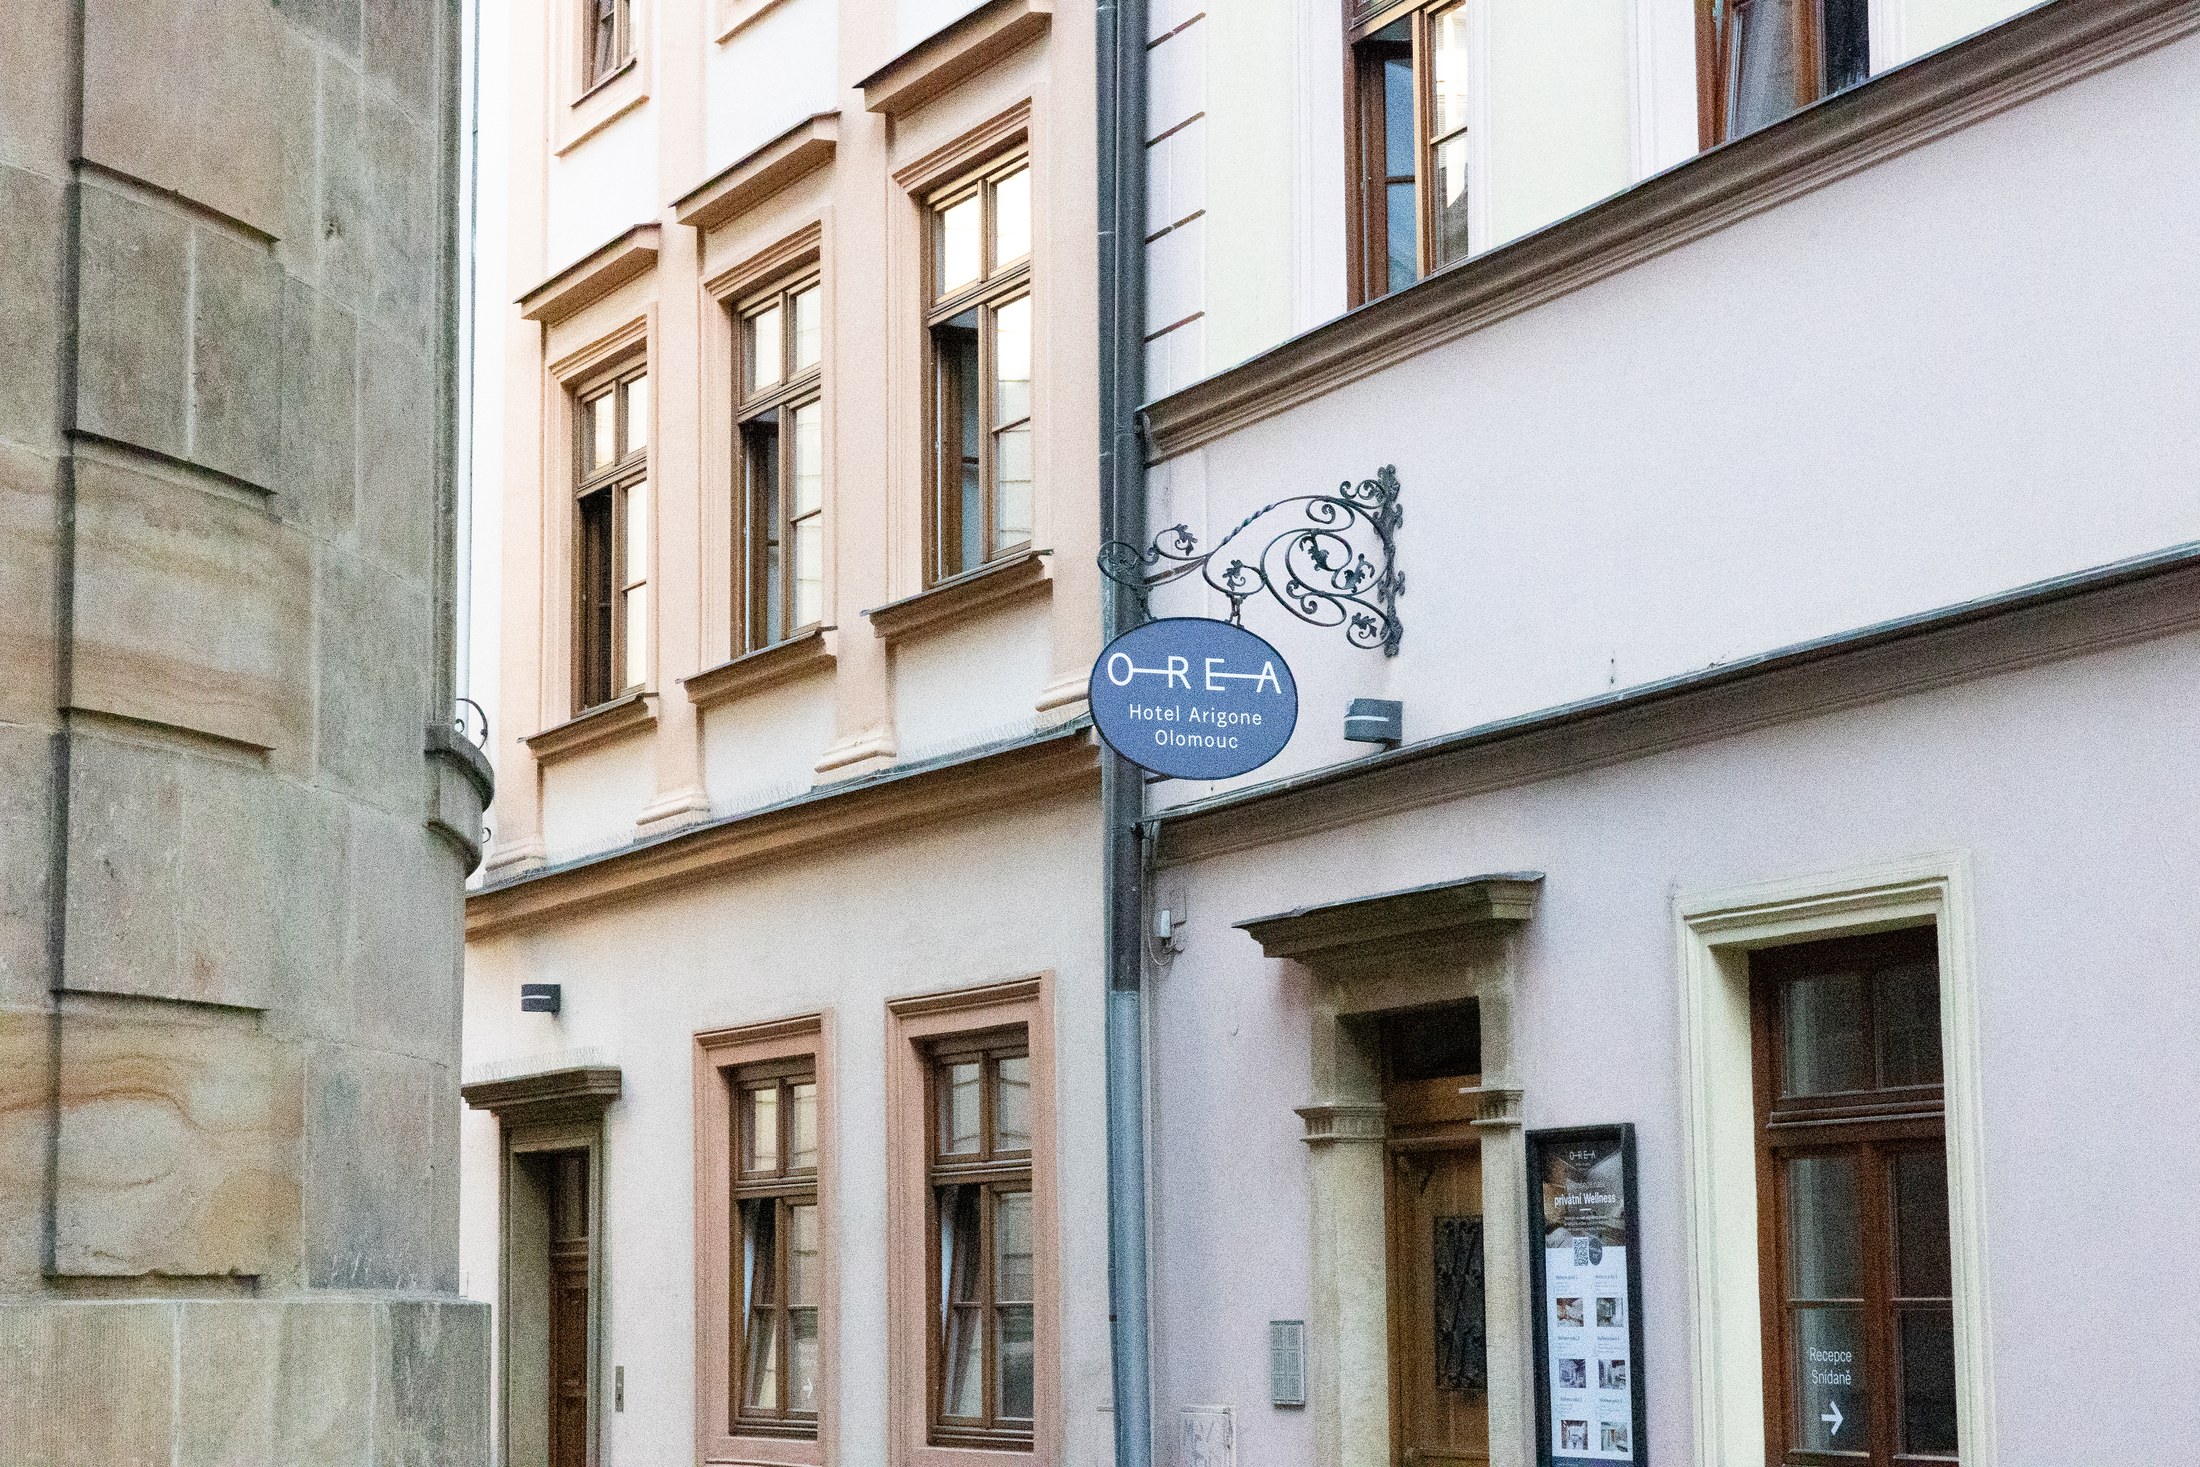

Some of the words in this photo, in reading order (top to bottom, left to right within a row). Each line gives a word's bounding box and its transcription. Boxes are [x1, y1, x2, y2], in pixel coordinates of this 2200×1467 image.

[1129, 704, 1179, 721] Hotel
[1189, 706, 1262, 727] Arigone
[1155, 730, 1238, 748] Olomouc
[1554, 1192, 1582, 1208] privátní
[1584, 1193, 1616, 1204] Wellness
[1809, 1347, 1852, 1365] Recepce
[1811, 1369, 1851, 1385] Snídaně
